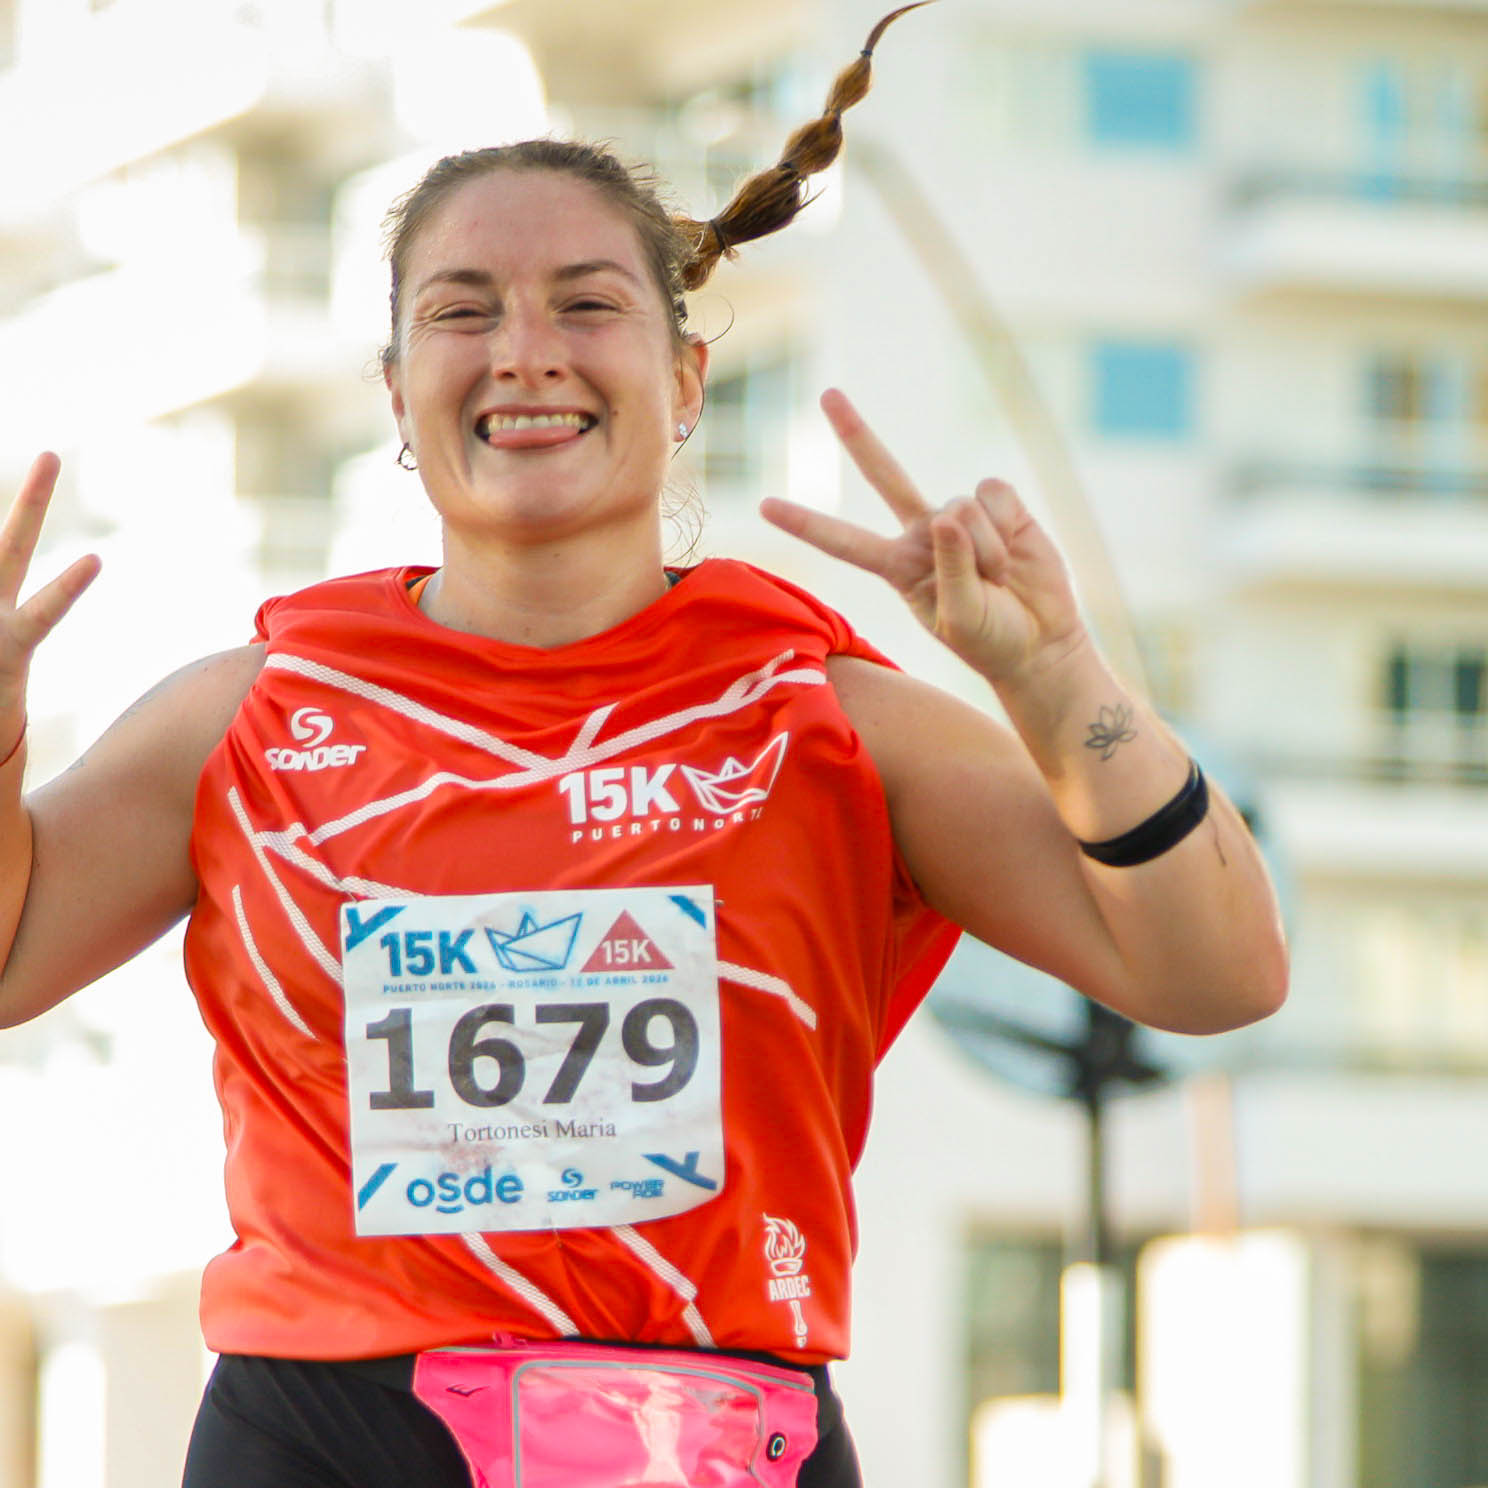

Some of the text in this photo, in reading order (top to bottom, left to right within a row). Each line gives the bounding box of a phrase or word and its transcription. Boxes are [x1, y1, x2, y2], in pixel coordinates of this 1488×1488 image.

[558, 763, 681, 825] 15K
[571, 817, 681, 844] PUERTO
[380, 928, 478, 977] 15K
[601, 938, 653, 966] 15K
[383, 982, 426, 993] PUERTO
[430, 981, 466, 991] NORTE
[365, 998, 700, 1110] 1679
[447, 1117, 617, 1143] Tortonesi Maria
[406, 1164, 525, 1214] osde
[768, 1275, 811, 1301] ARDEC
